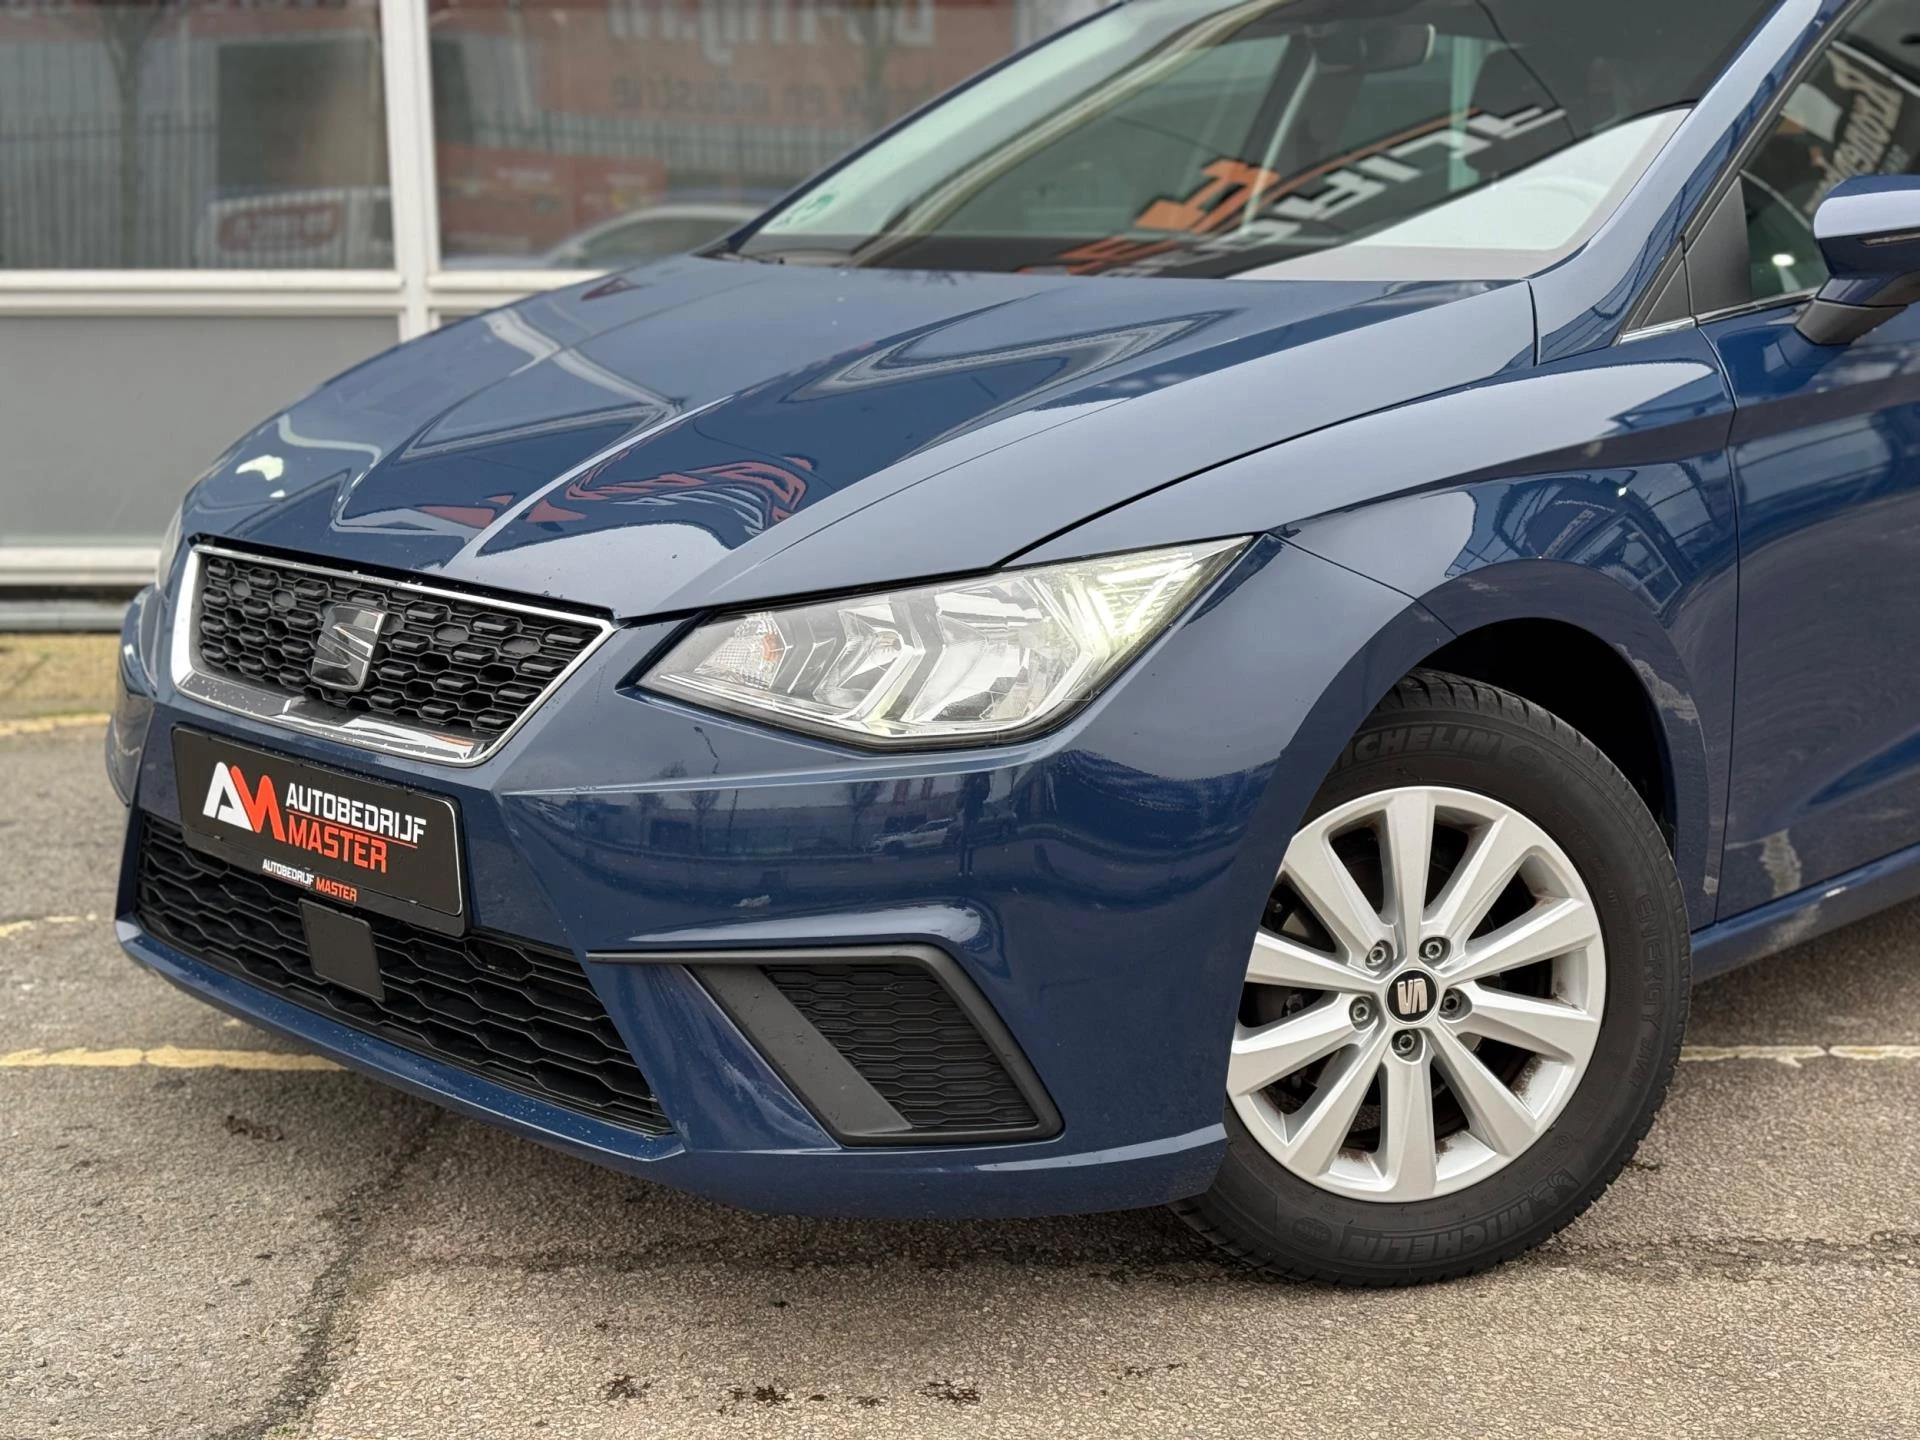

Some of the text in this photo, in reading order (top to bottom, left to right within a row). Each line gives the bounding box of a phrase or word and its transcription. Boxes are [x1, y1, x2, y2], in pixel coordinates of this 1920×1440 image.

[1330, 726, 1500, 770] ICHELIN
[285, 782, 427, 844] AUTOBEDRIJF
[287, 814, 388, 874] MASTER
[262, 858, 358, 903] AUTOBEDRIJF MASTER
[1349, 1199, 1535, 1262] MICHELIN
